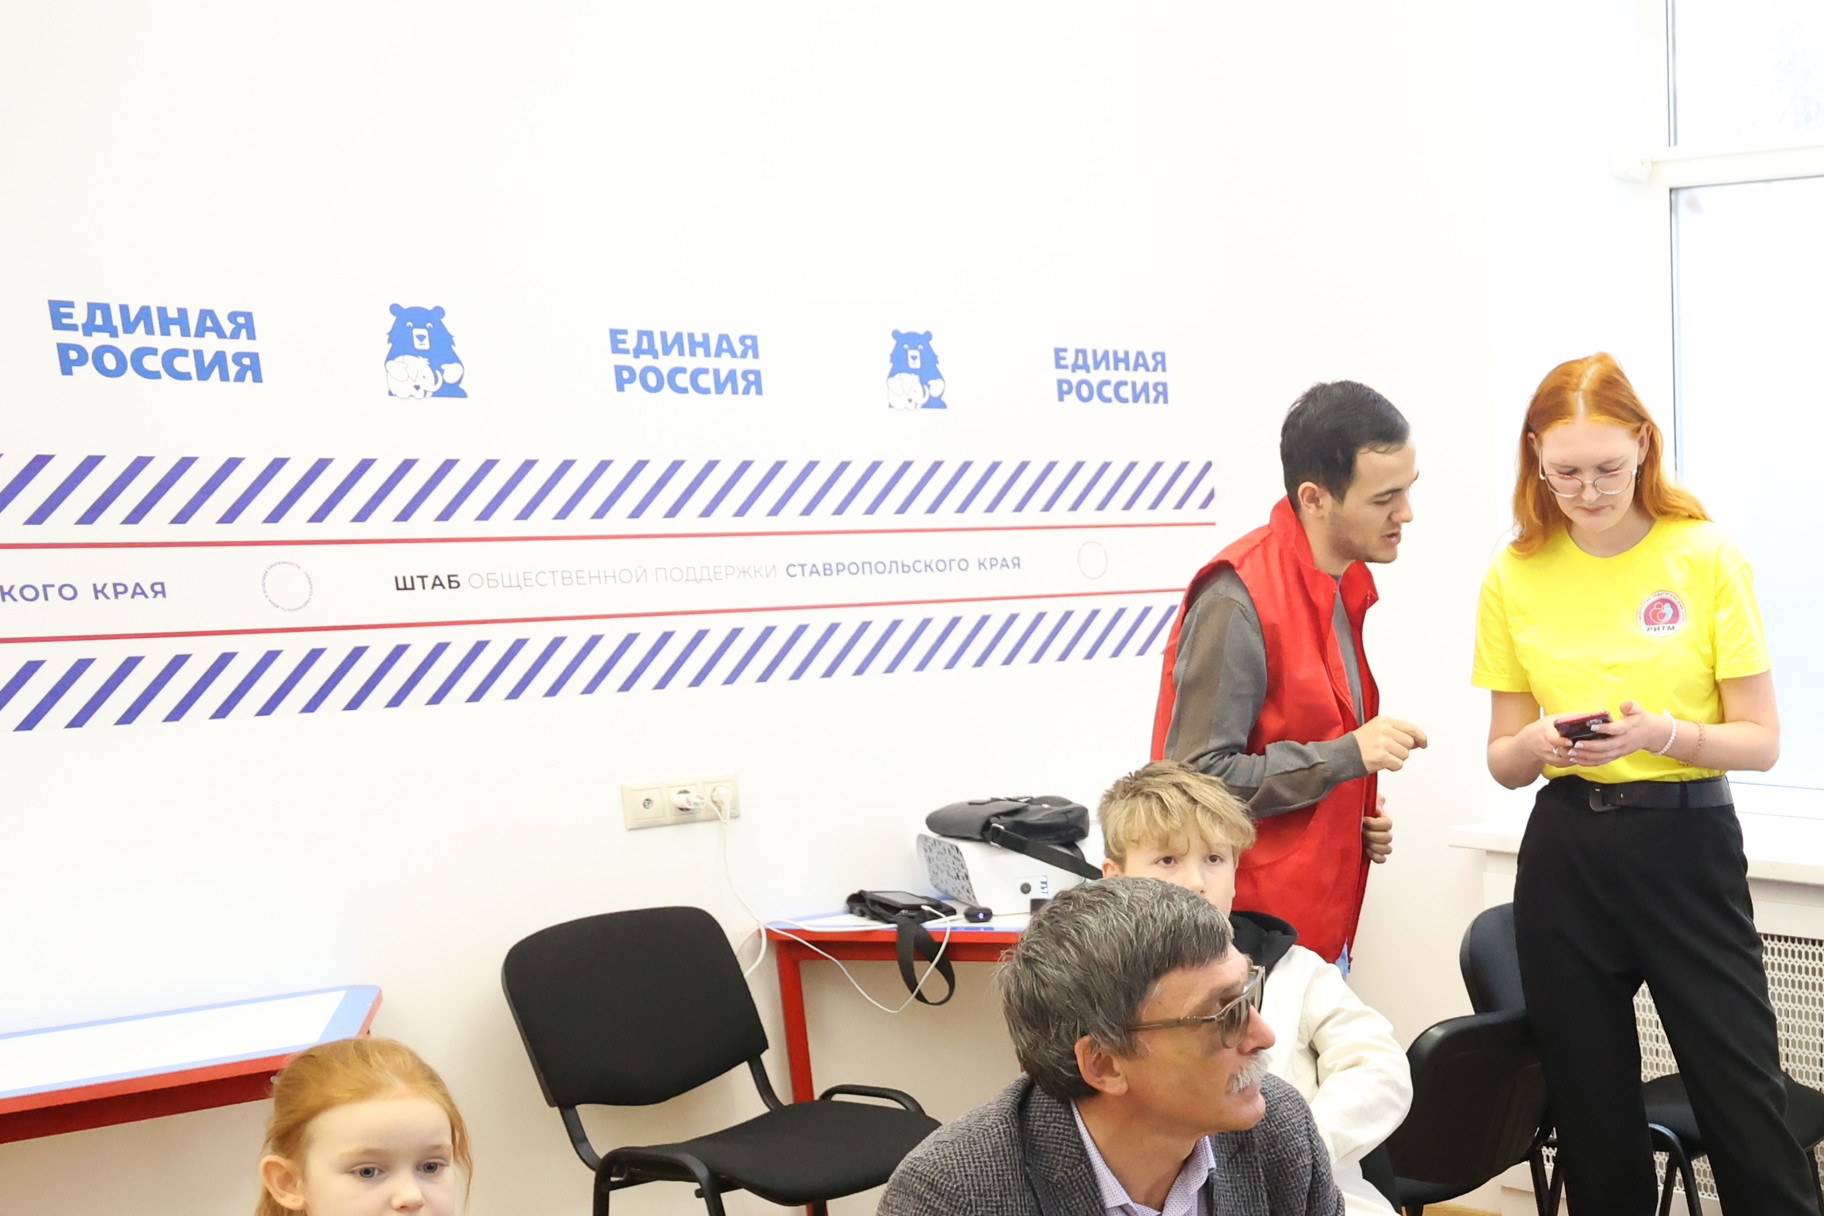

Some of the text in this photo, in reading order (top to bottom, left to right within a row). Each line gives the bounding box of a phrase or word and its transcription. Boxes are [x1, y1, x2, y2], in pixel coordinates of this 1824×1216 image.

[48, 299, 257, 340] ЕДИНАЯ
[609, 328, 760, 360] ЕДИНАЯ
[1053, 347, 1167, 373] ЕДИНАЯ
[56, 342, 263, 383] РОССИЯ
[613, 364, 763, 396] РОССИЯ
[1056, 378, 1169, 405] РОССИЯ
[394, 556, 1021, 591] ШТАБ ОБЩЕСТВЕННОЙ ПОДДЕРЖКИ СТАВРОПОЛЬСКОГО КРАЯ
[92, 581, 167, 600] КРАЯ
